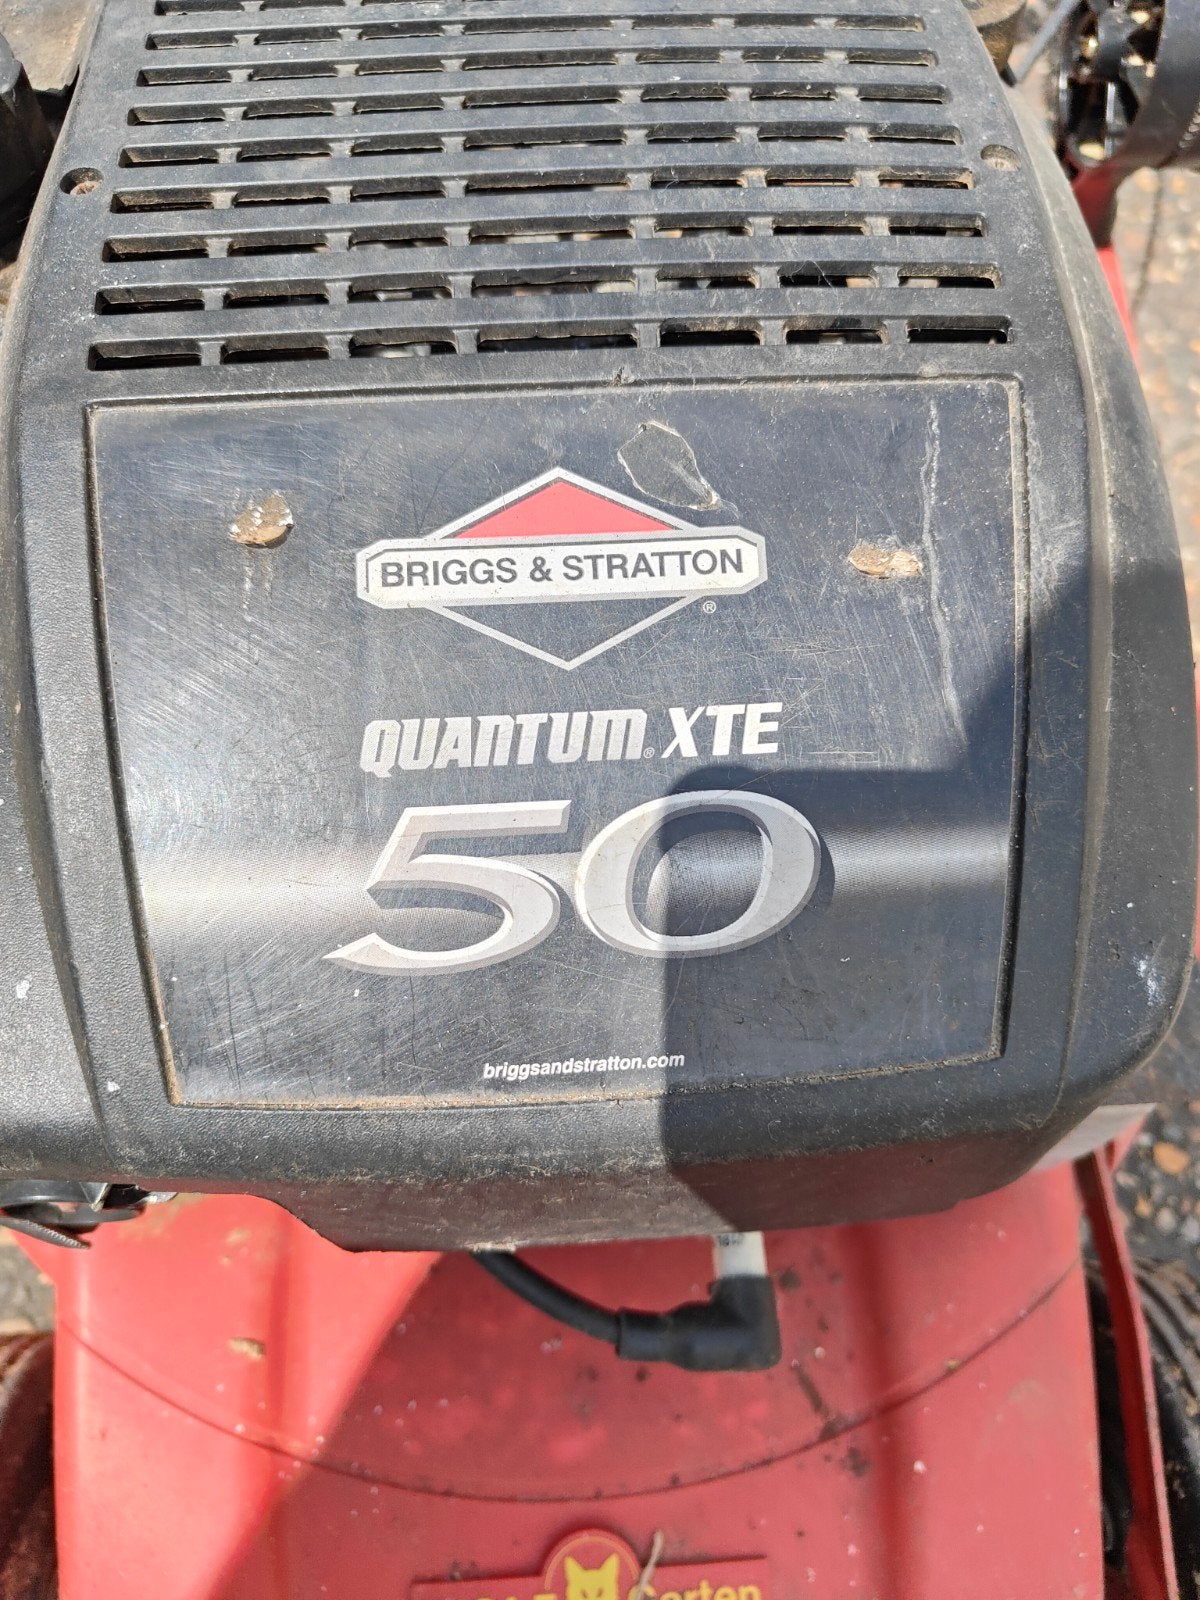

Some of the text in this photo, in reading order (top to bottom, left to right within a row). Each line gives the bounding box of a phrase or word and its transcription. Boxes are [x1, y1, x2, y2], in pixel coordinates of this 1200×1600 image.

[381, 549, 744, 588] BRIGGS & STRATTON
[660, 702, 783, 759] XTE
[322, 789, 822, 977] 50
[483, 1054, 685, 1081] briggsandstratton.com
